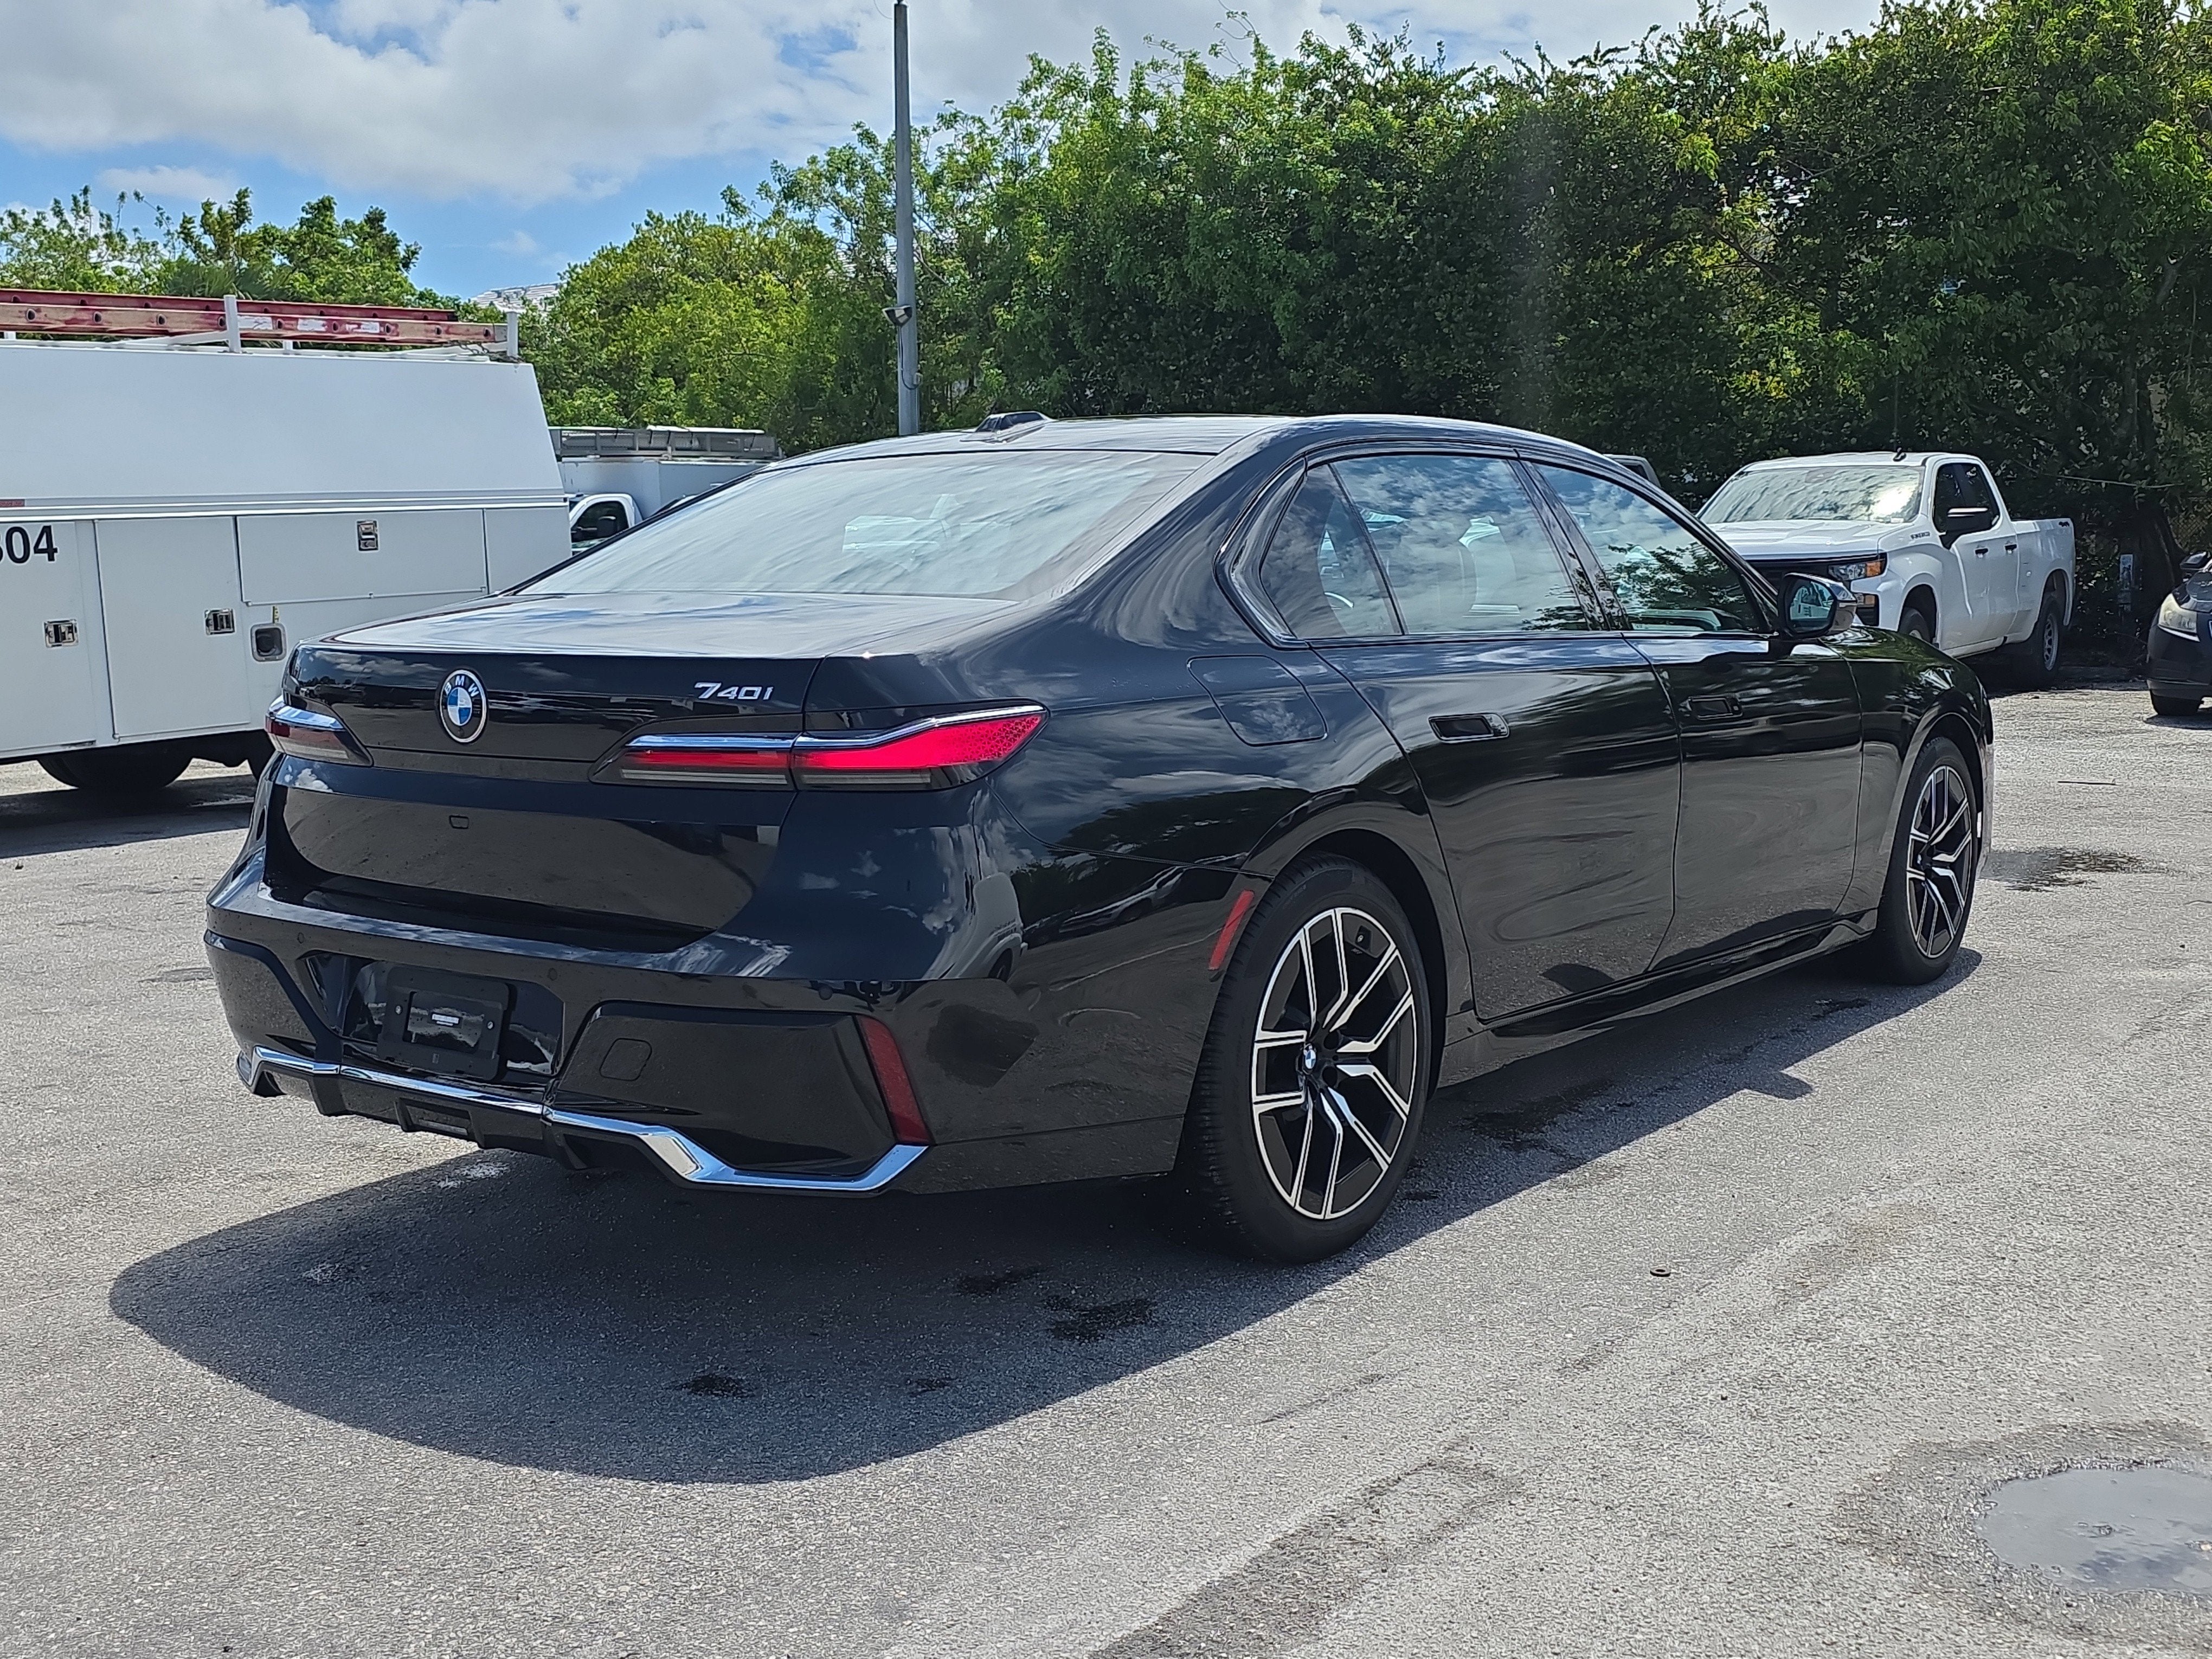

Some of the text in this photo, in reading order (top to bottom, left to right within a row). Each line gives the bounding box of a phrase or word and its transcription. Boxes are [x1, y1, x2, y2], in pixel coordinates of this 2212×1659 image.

[0, 525, 58, 564] 04
[443, 675, 480, 697] BMW
[694, 682, 774, 700] 740i
